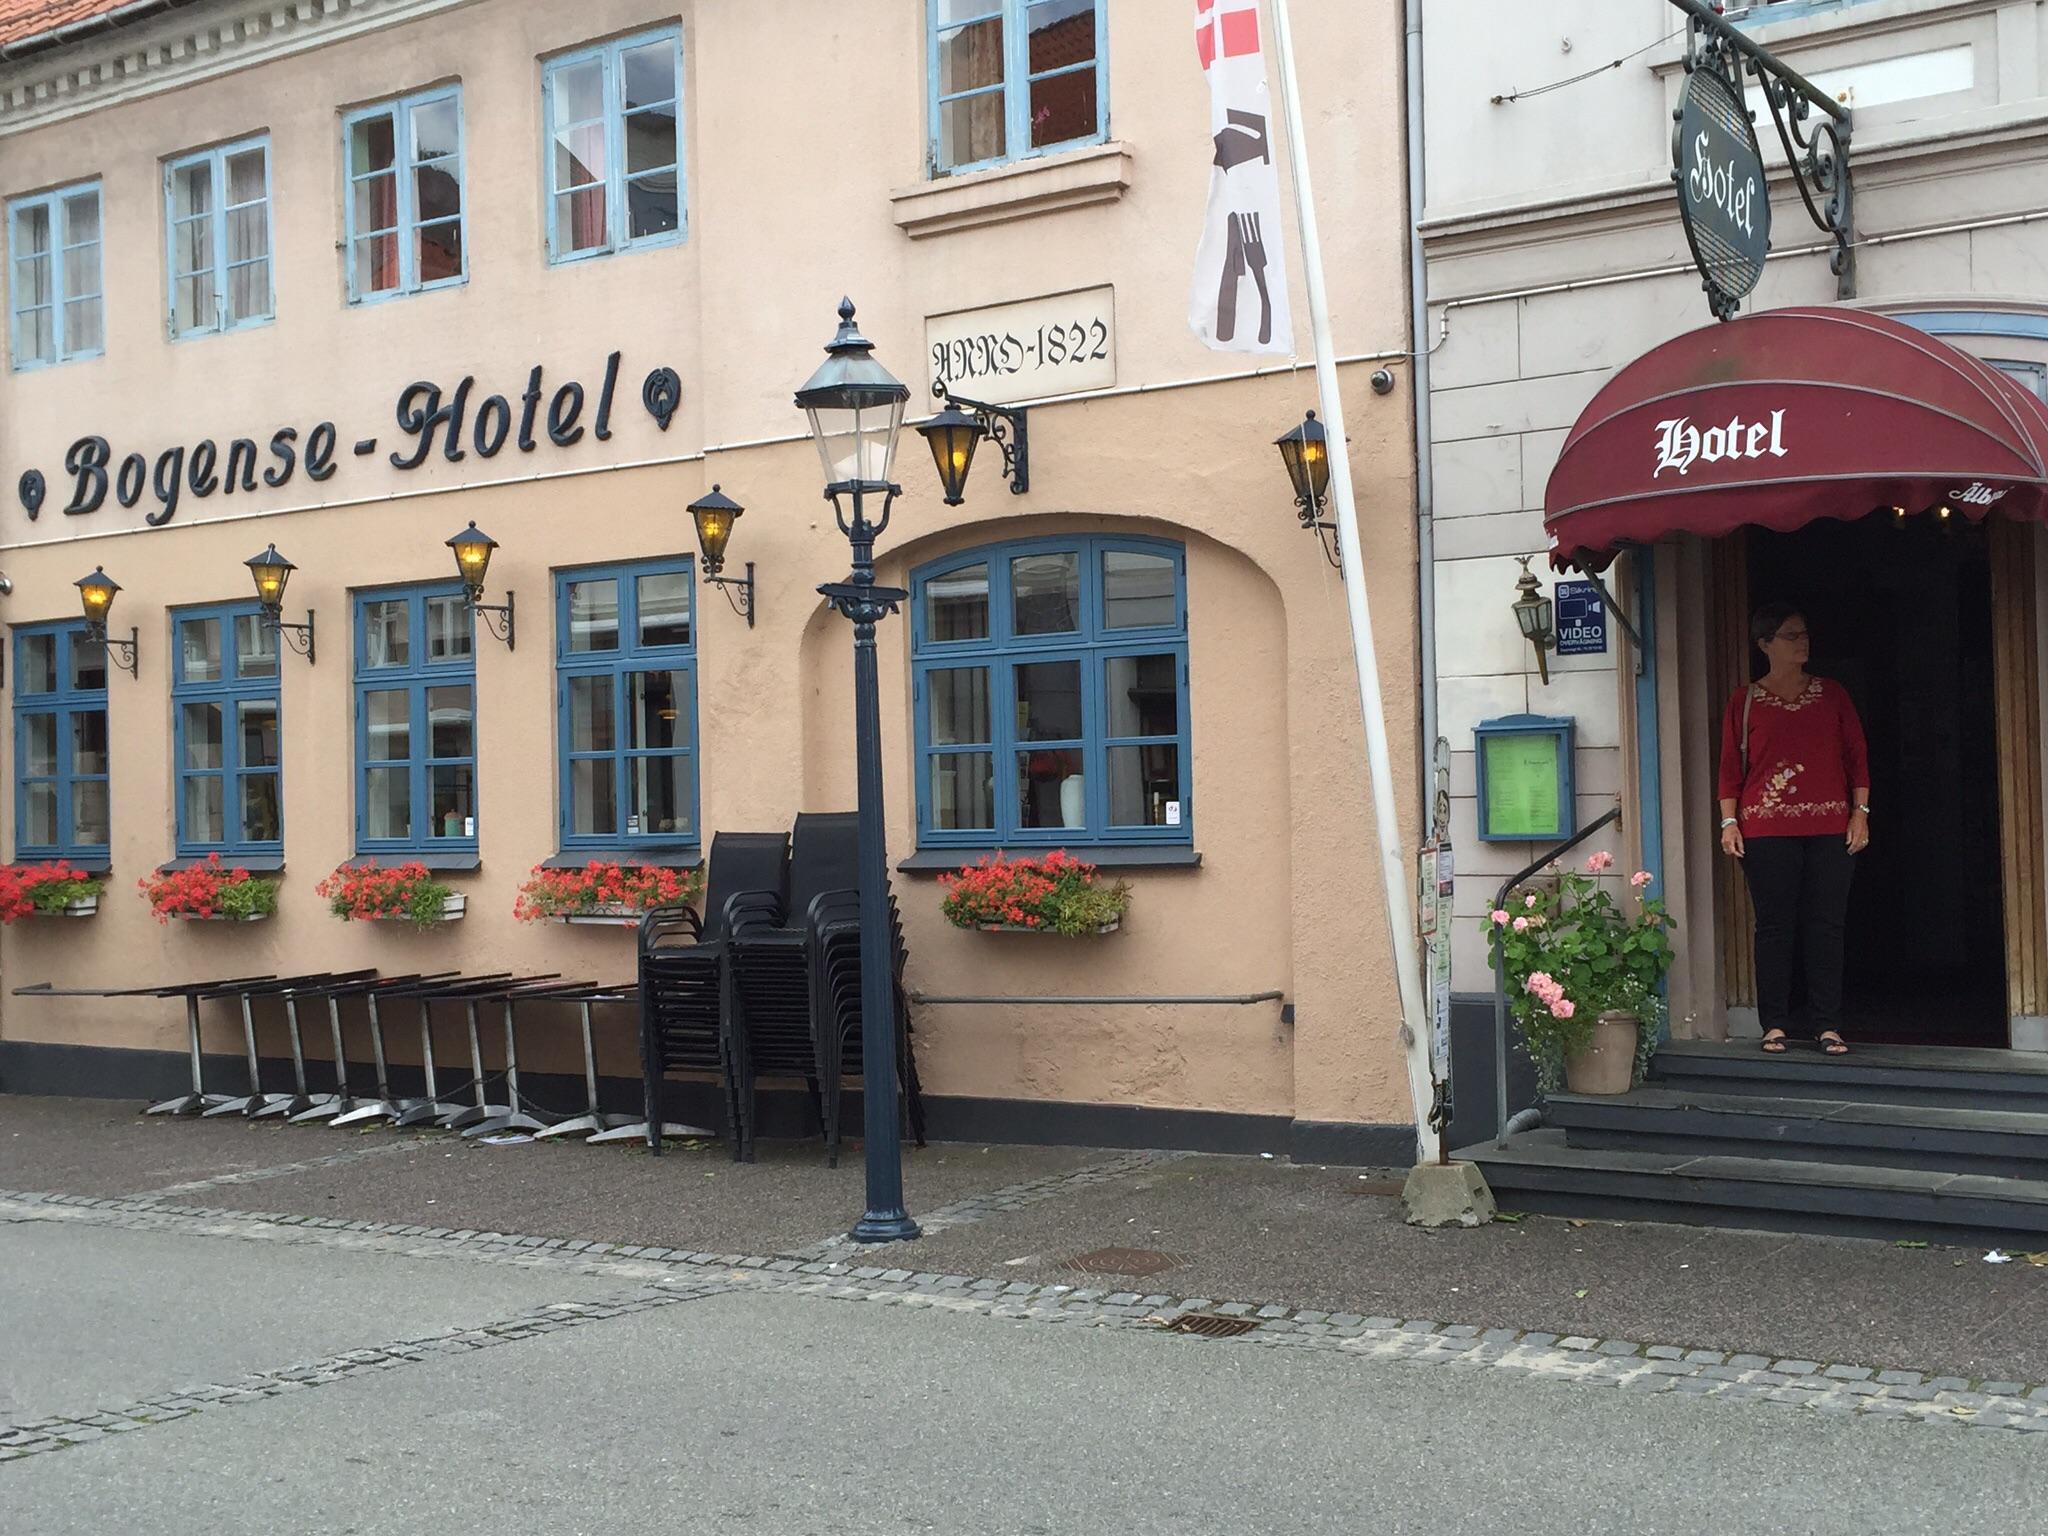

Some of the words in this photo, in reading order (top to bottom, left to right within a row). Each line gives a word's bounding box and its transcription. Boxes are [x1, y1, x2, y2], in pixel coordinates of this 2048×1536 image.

[1690, 130, 1755, 239] Hotel
[1653, 408, 1788, 478] Hotel
[1559, 625, 1602, 640] VIDEO
